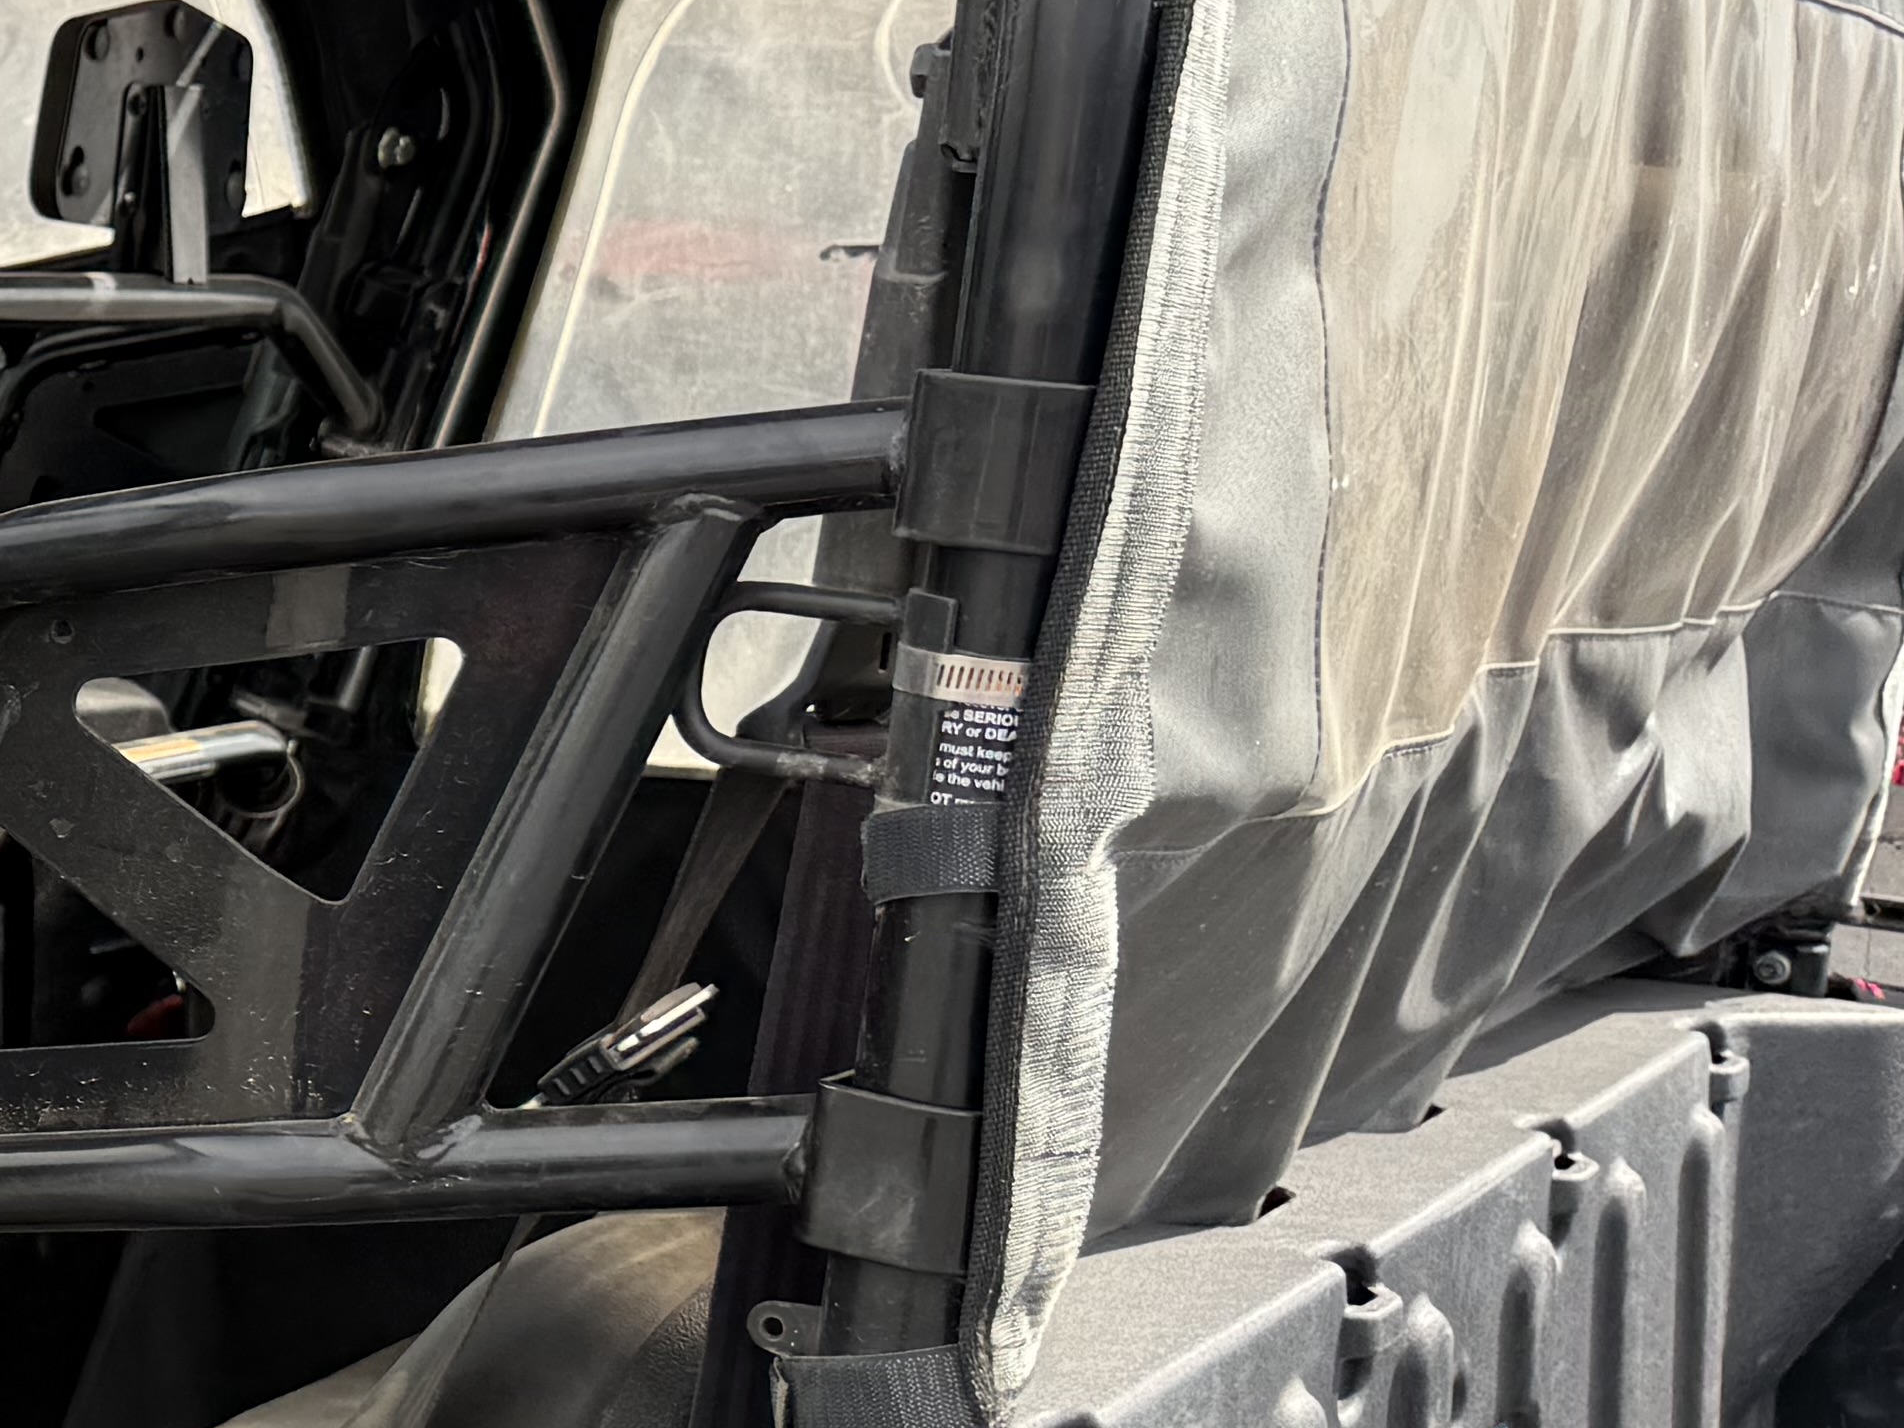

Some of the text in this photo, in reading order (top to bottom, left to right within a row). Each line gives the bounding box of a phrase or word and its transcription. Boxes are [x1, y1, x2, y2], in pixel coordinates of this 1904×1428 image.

[941, 721, 963, 735] RY
[965, 727, 982, 738] or
[939, 743, 1012, 764] must keep
[943, 757, 958, 770] of
[960, 761, 994, 774] your
[947, 773, 971, 787] the
